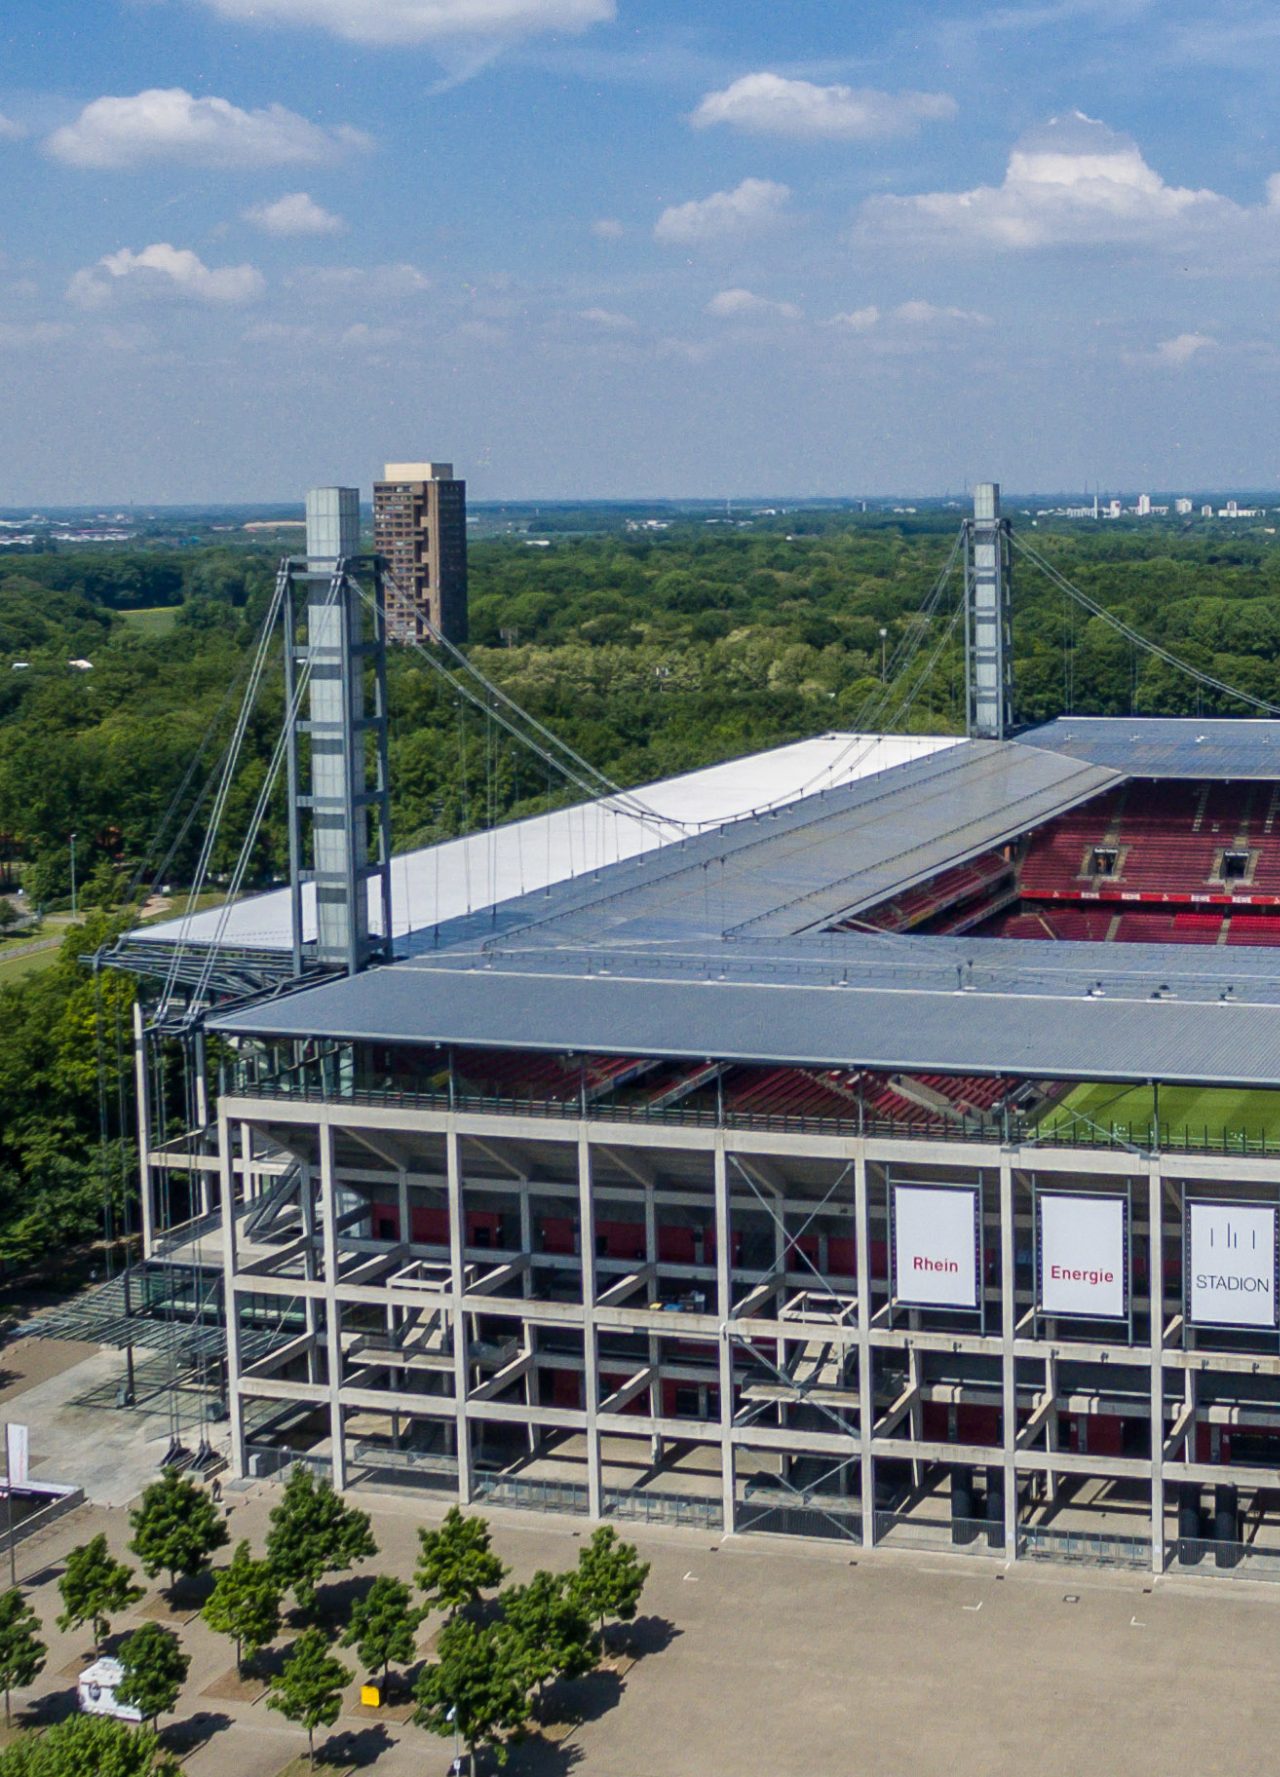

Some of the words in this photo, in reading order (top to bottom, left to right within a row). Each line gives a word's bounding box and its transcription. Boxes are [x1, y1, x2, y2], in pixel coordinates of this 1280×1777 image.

[1190, 784, 1220, 832] 1.
[913, 1256, 958, 1274] Rhein
[1050, 1265, 1114, 1286] Energie
[1196, 1273, 1270, 1293] STADION
